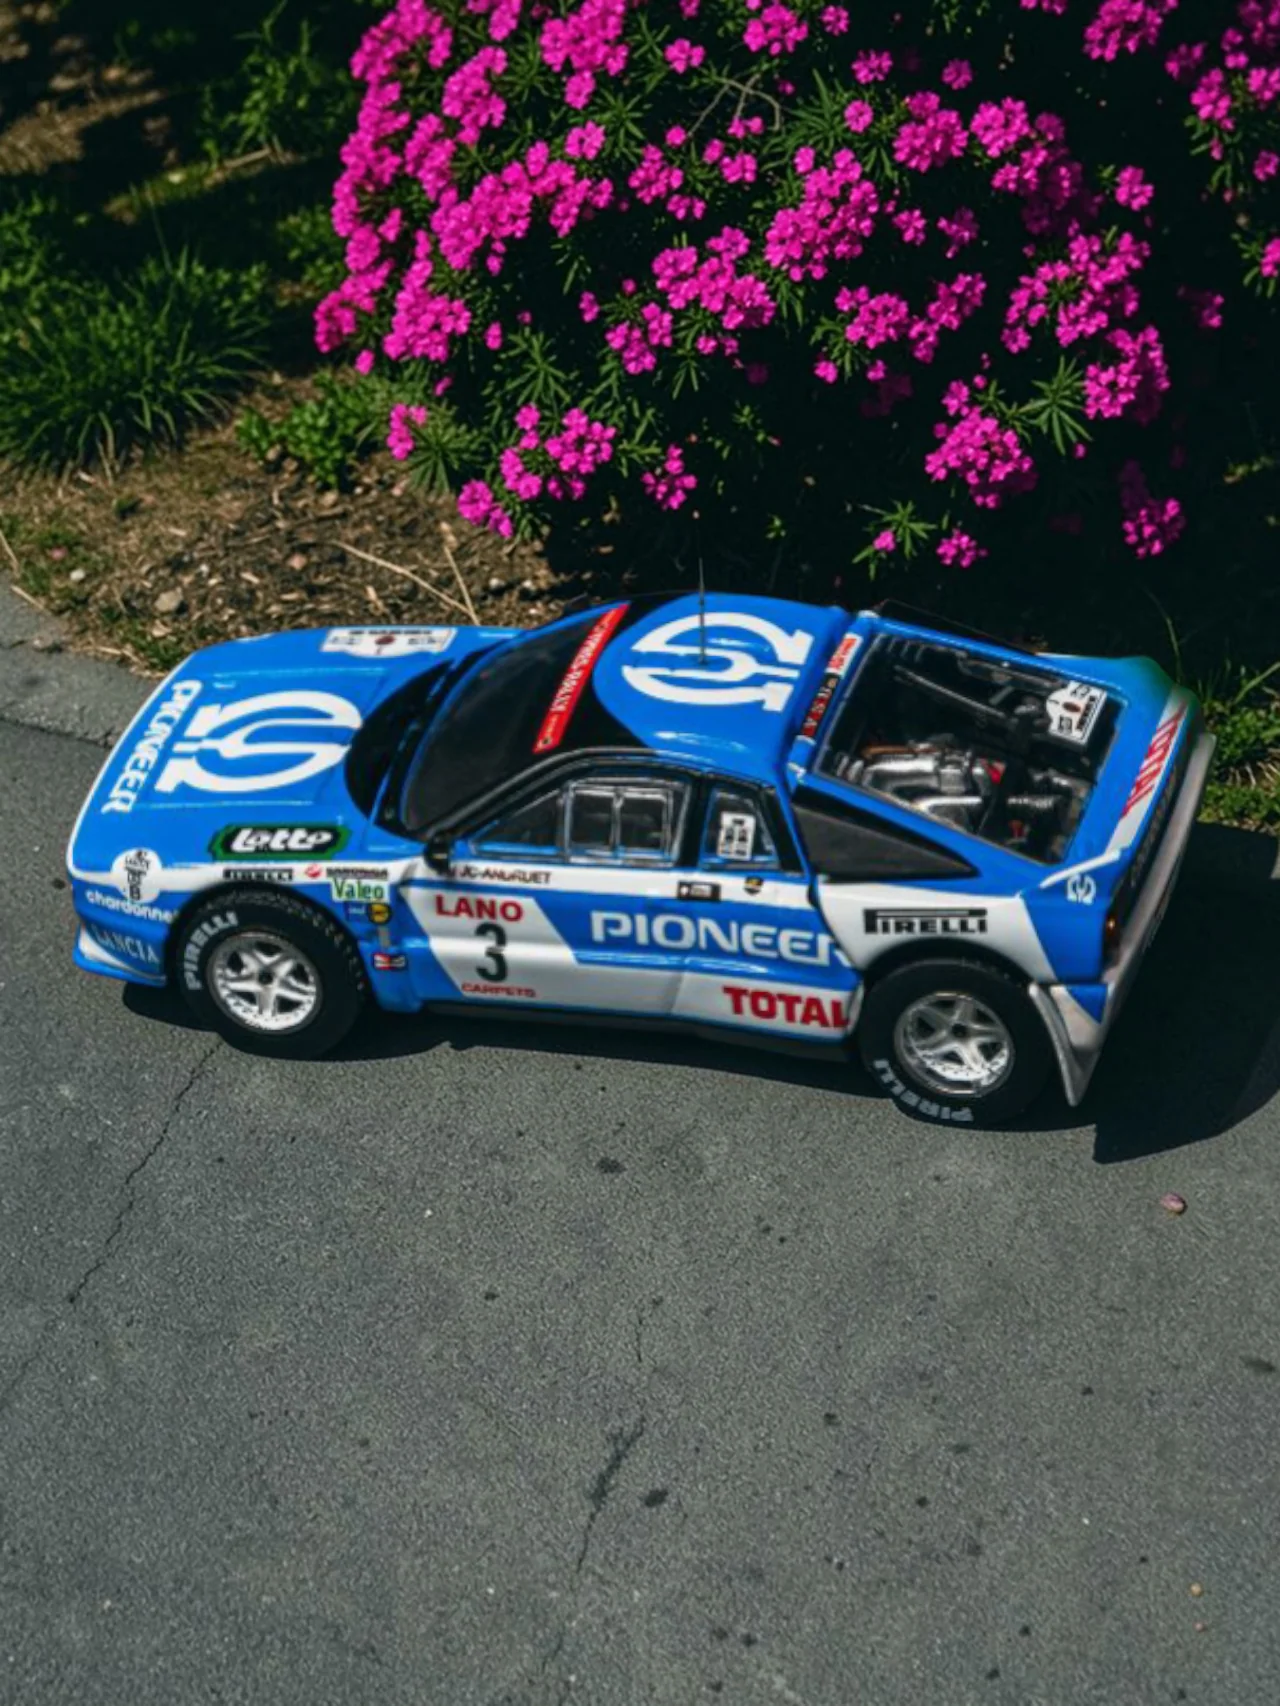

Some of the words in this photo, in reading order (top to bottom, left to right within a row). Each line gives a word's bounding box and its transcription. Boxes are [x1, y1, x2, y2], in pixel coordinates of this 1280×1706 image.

[231, 827, 333, 853] Lotto
[85, 889, 178, 924] chardonne
[332, 879, 385, 899] Valeo
[434, 894, 524, 922] LANO
[862, 907, 988, 934] PIRELLI
[183, 911, 239, 991] PIRELLI
[474, 921, 508, 983] 3
[722, 984, 849, 1029] TOTAL
[874, 1059, 975, 1122] PIRELLI
